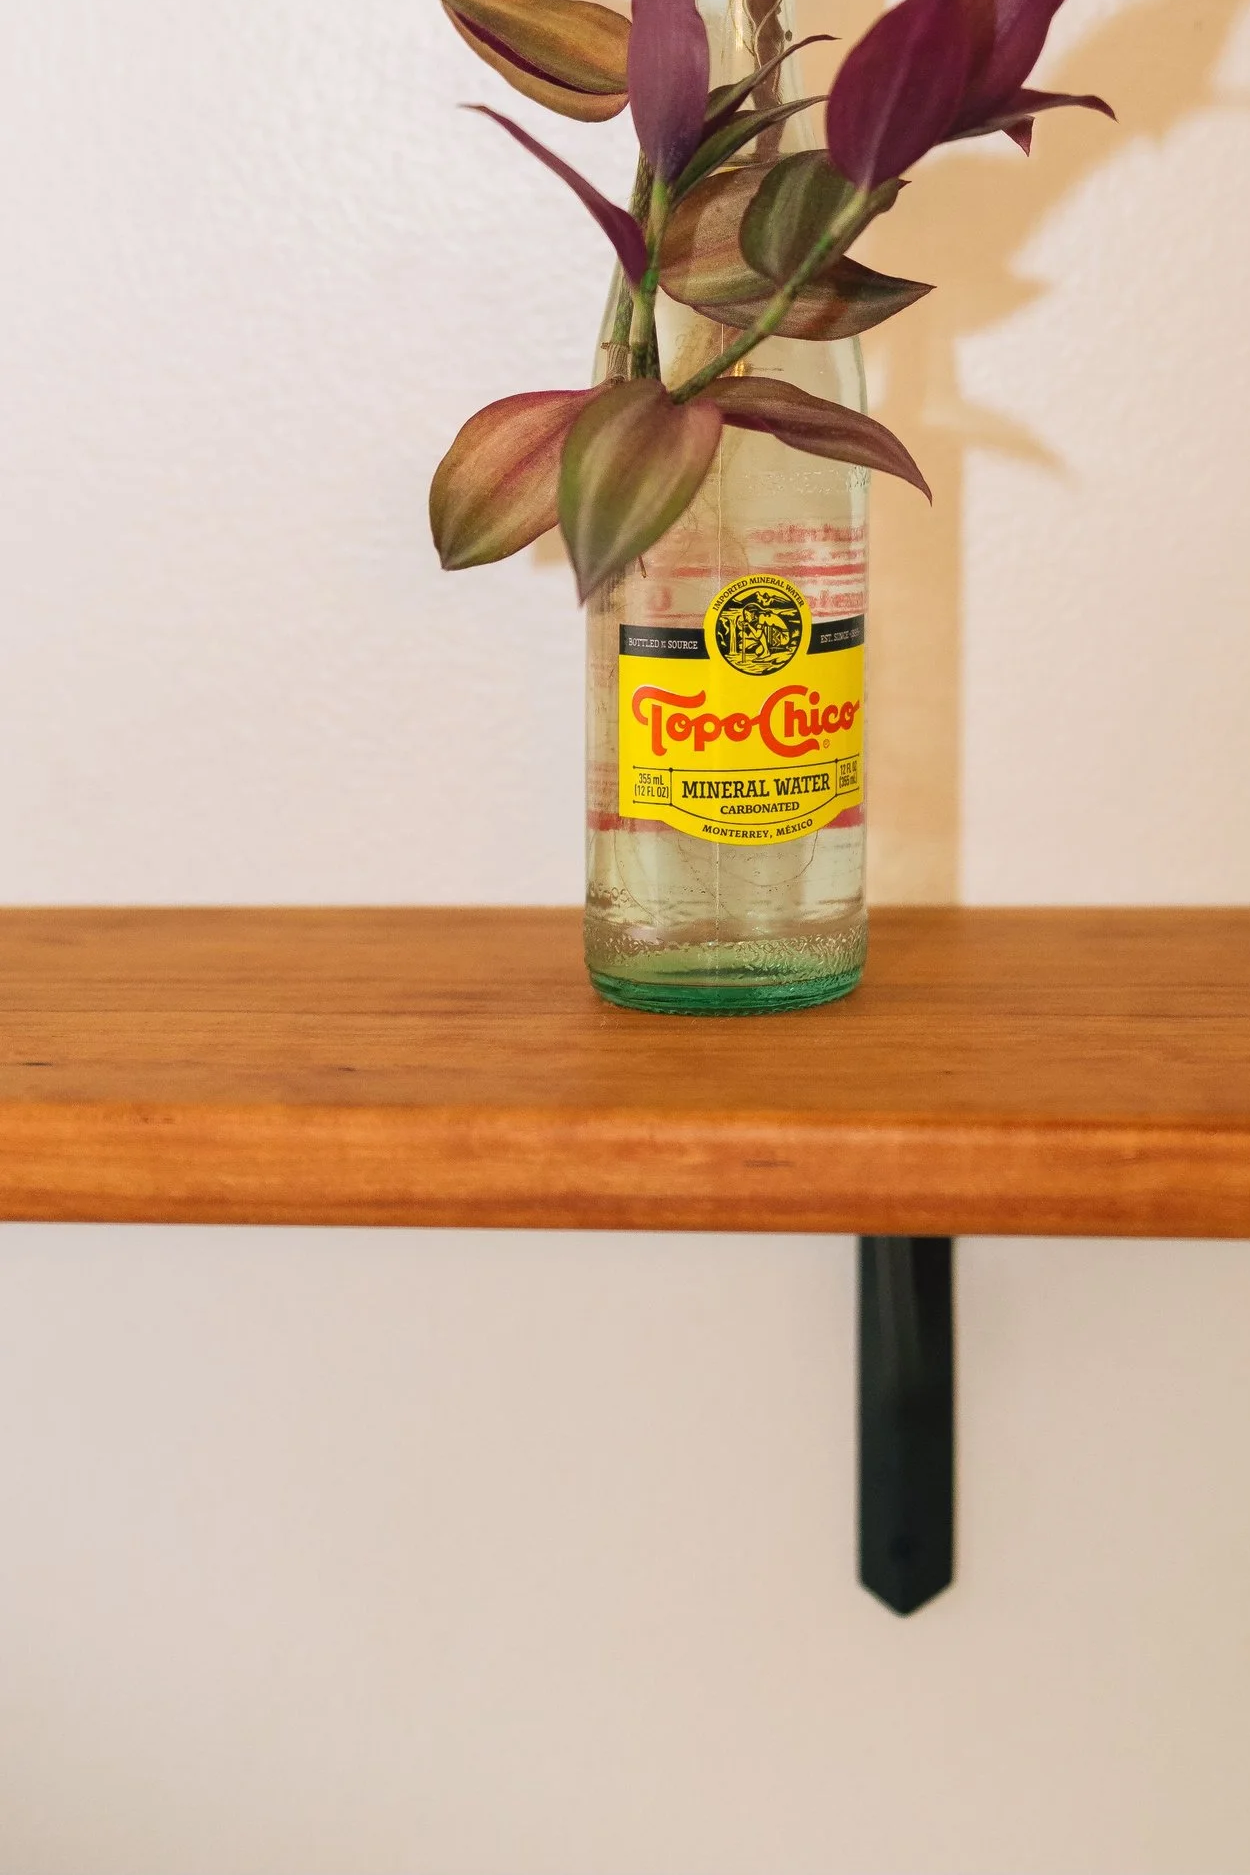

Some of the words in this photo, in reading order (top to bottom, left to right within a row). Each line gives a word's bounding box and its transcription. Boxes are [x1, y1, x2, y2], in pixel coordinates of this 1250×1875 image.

[712, 580, 749, 612] IMPORTED
[749, 577, 785, 588] MINERAL
[785, 583, 806, 609] WATER
[628, 637, 660, 649] BOTTLED
[667, 640, 698, 650] SOURCE
[632, 684, 760, 757] Topo
[760, 684, 860, 758] Chico
[639, 773, 652, 785] 355
[681, 780, 770, 799] MINERAL
[774, 773, 830, 797] WATER
[634, 784, 646, 797] (12
[647, 785, 656, 797] FL
[656, 785, 669, 799] OZ)
[720, 801, 800, 815] CARBONATED
[702, 823, 773, 839] MONTERREY,
[775, 818, 814, 837] MÉXICO
